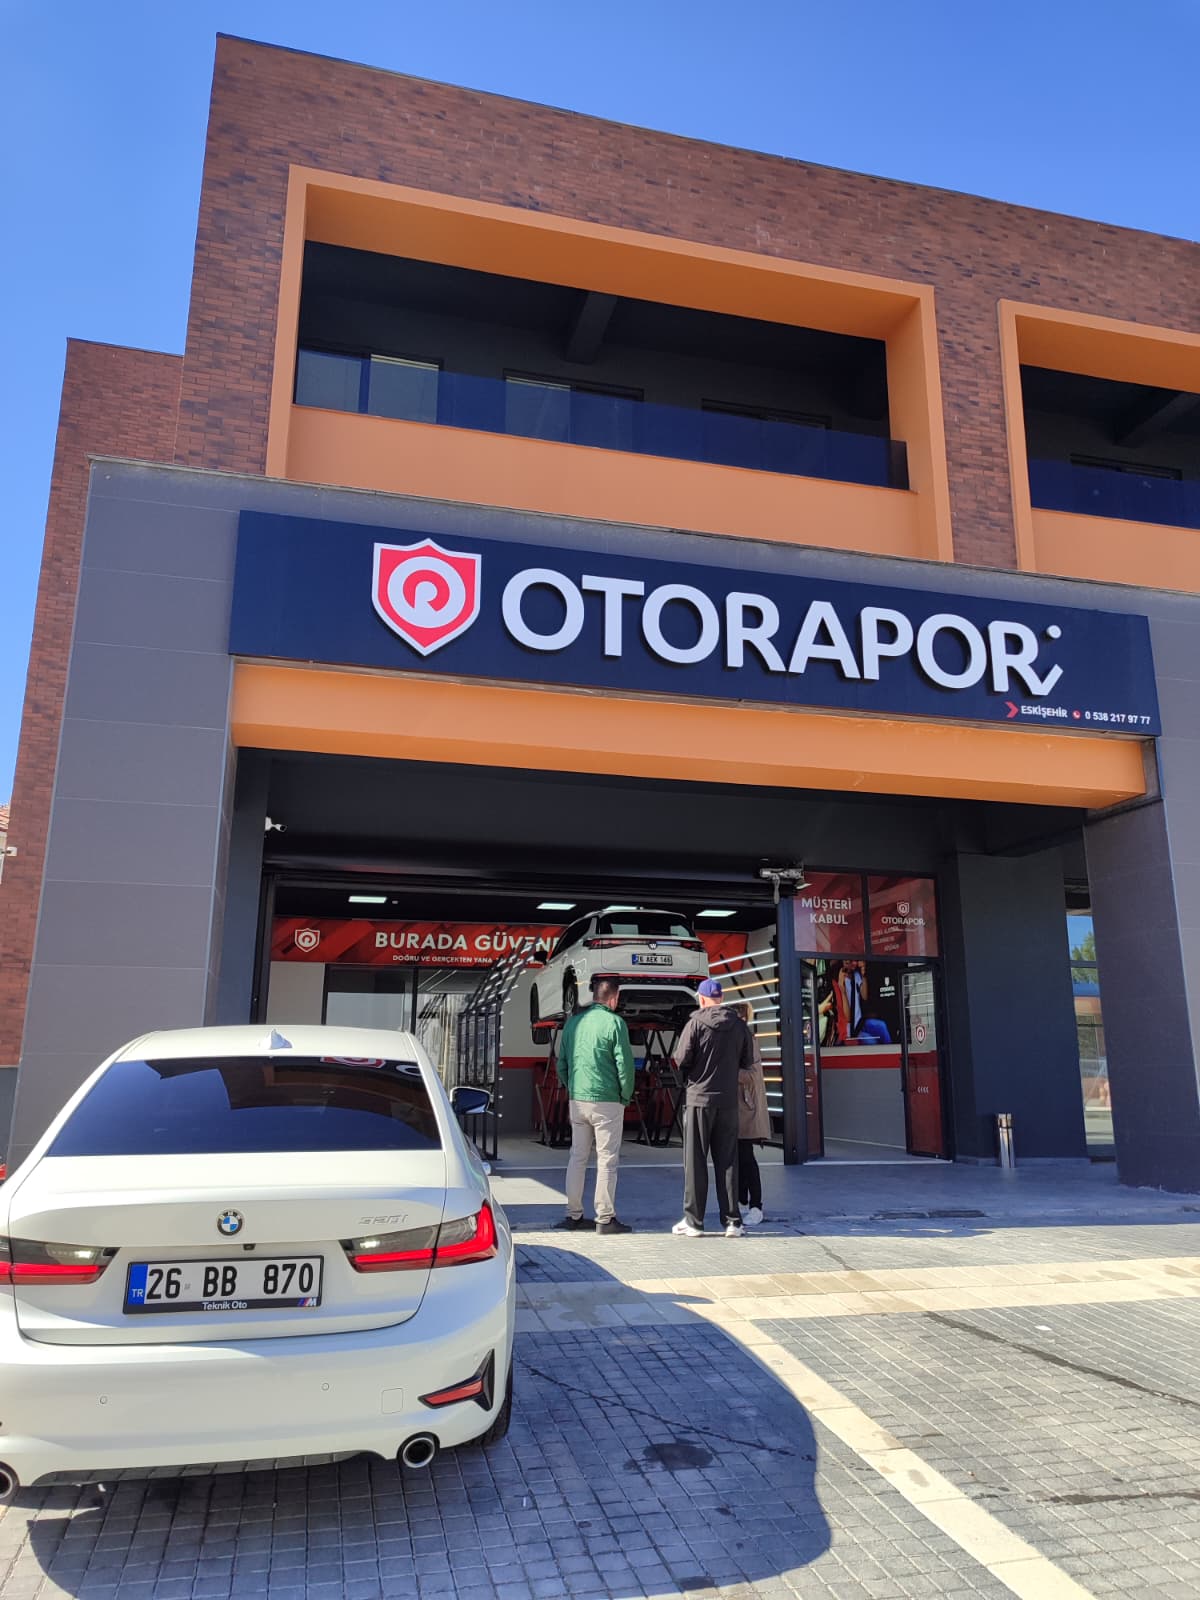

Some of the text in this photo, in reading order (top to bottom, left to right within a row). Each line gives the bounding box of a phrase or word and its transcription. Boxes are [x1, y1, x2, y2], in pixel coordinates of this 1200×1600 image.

[502, 568, 1064, 696] OTORAPOR
[1020, 705, 1151, 725] ESKİŞEHİR 0 538 217 97 77
[801, 896, 852, 911] MÜŞTERİ
[809, 913, 848, 925] KABUL
[375, 932, 468, 950] BURADA
[392, 953, 420, 962] DOĞRU
[132, 1263, 314, 1300] TR 26 BB 870
[202, 1301, 248, 1311] Teknik Oto
